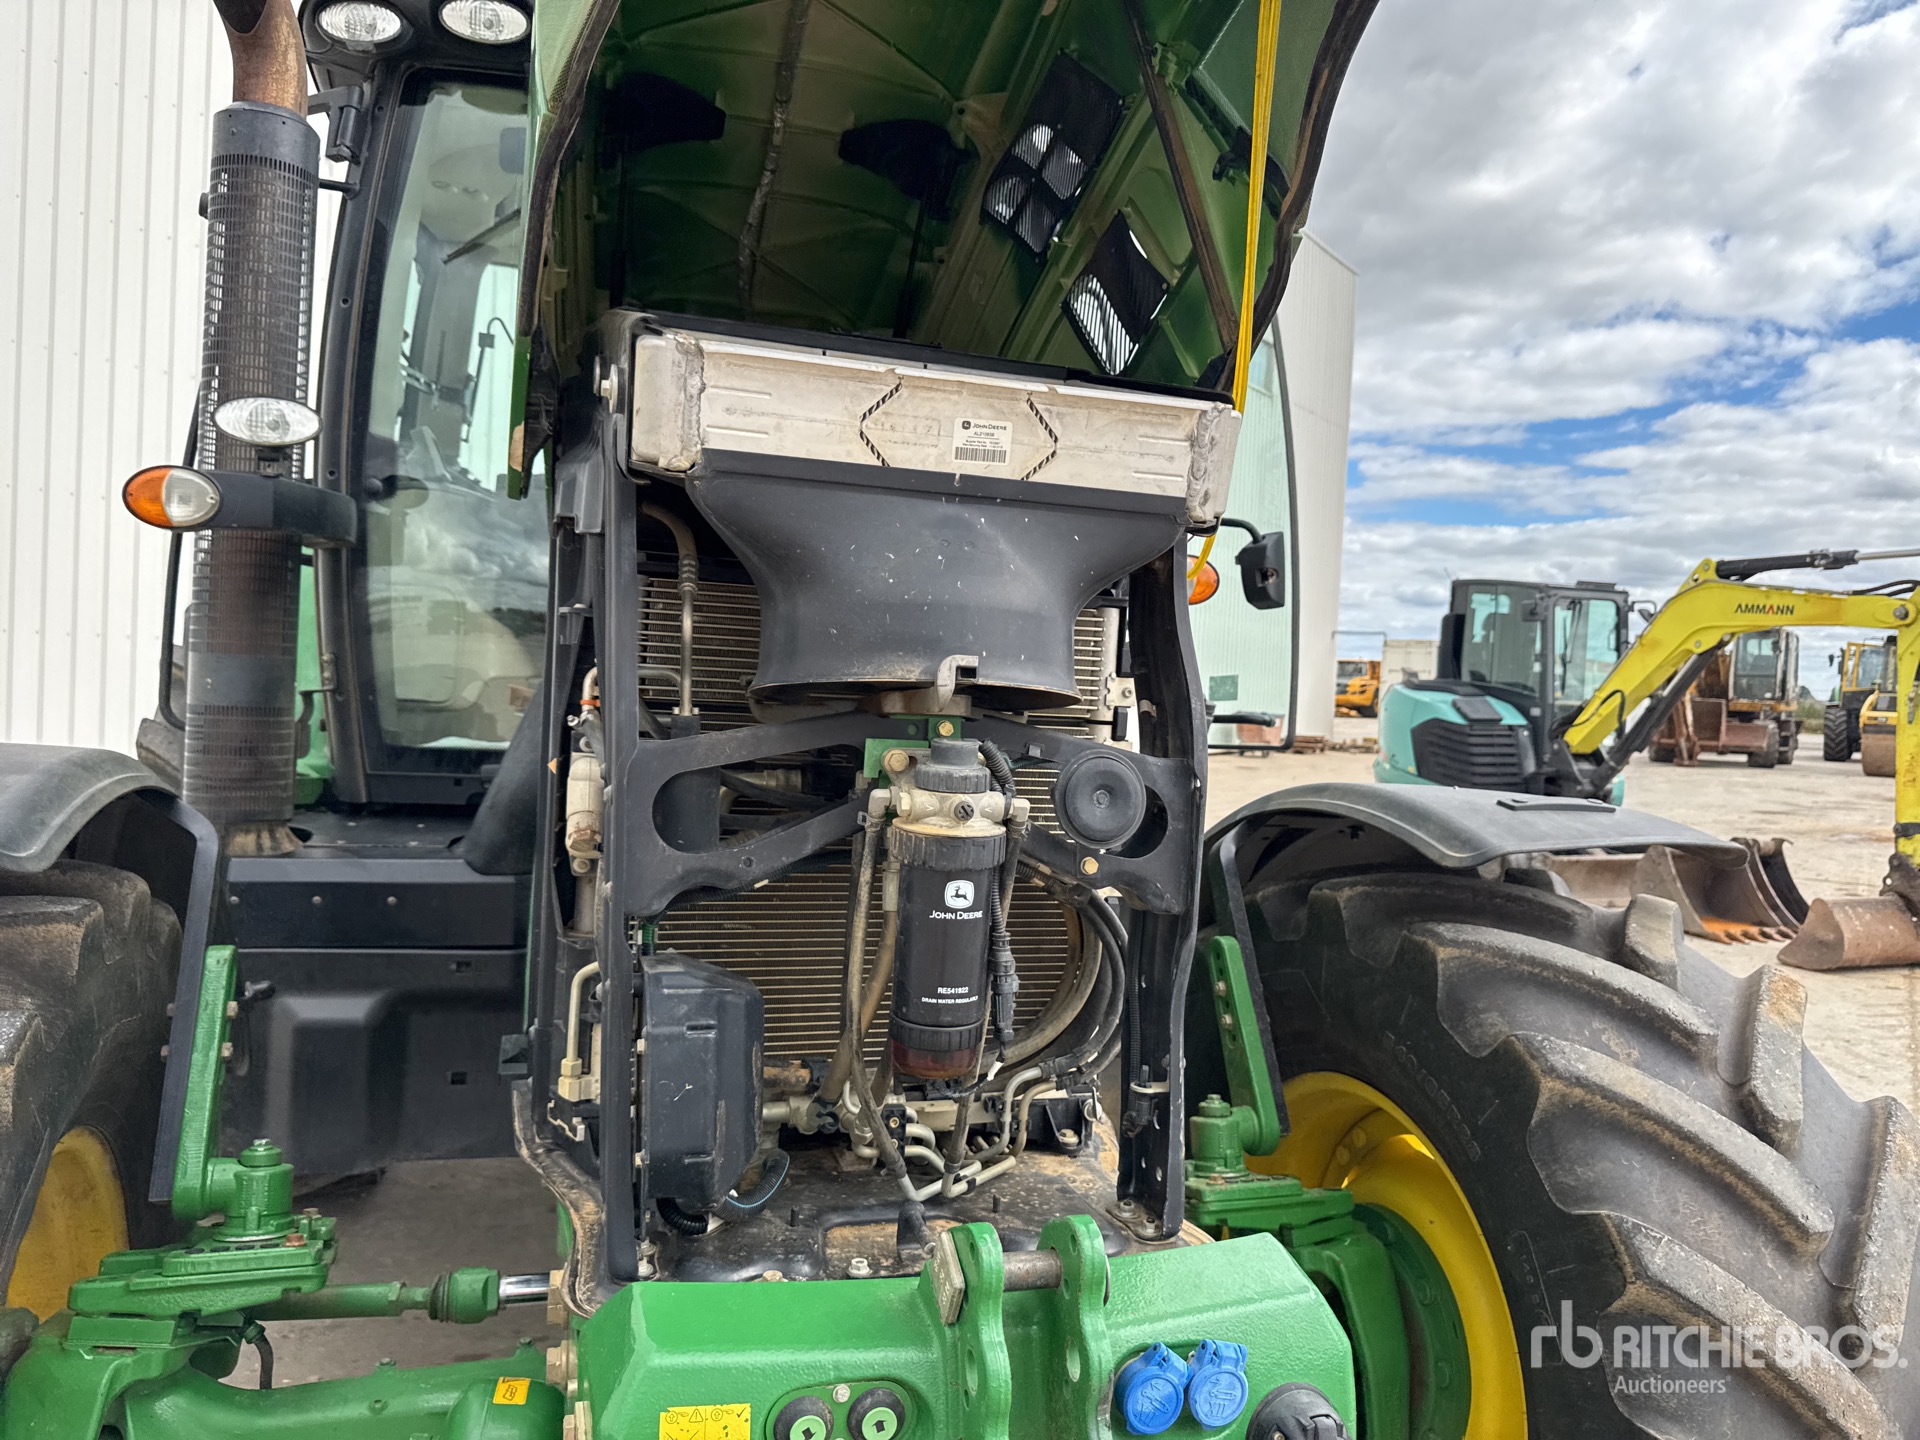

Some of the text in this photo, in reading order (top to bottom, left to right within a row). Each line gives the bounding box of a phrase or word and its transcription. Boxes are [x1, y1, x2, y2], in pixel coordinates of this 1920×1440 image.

[972, 422, 1007, 431] JOHN DEERE
[1734, 602, 1795, 616] AMMANN
[929, 910, 983, 920] JOHN DEERE
[937, 986, 969, 994] RE541922
